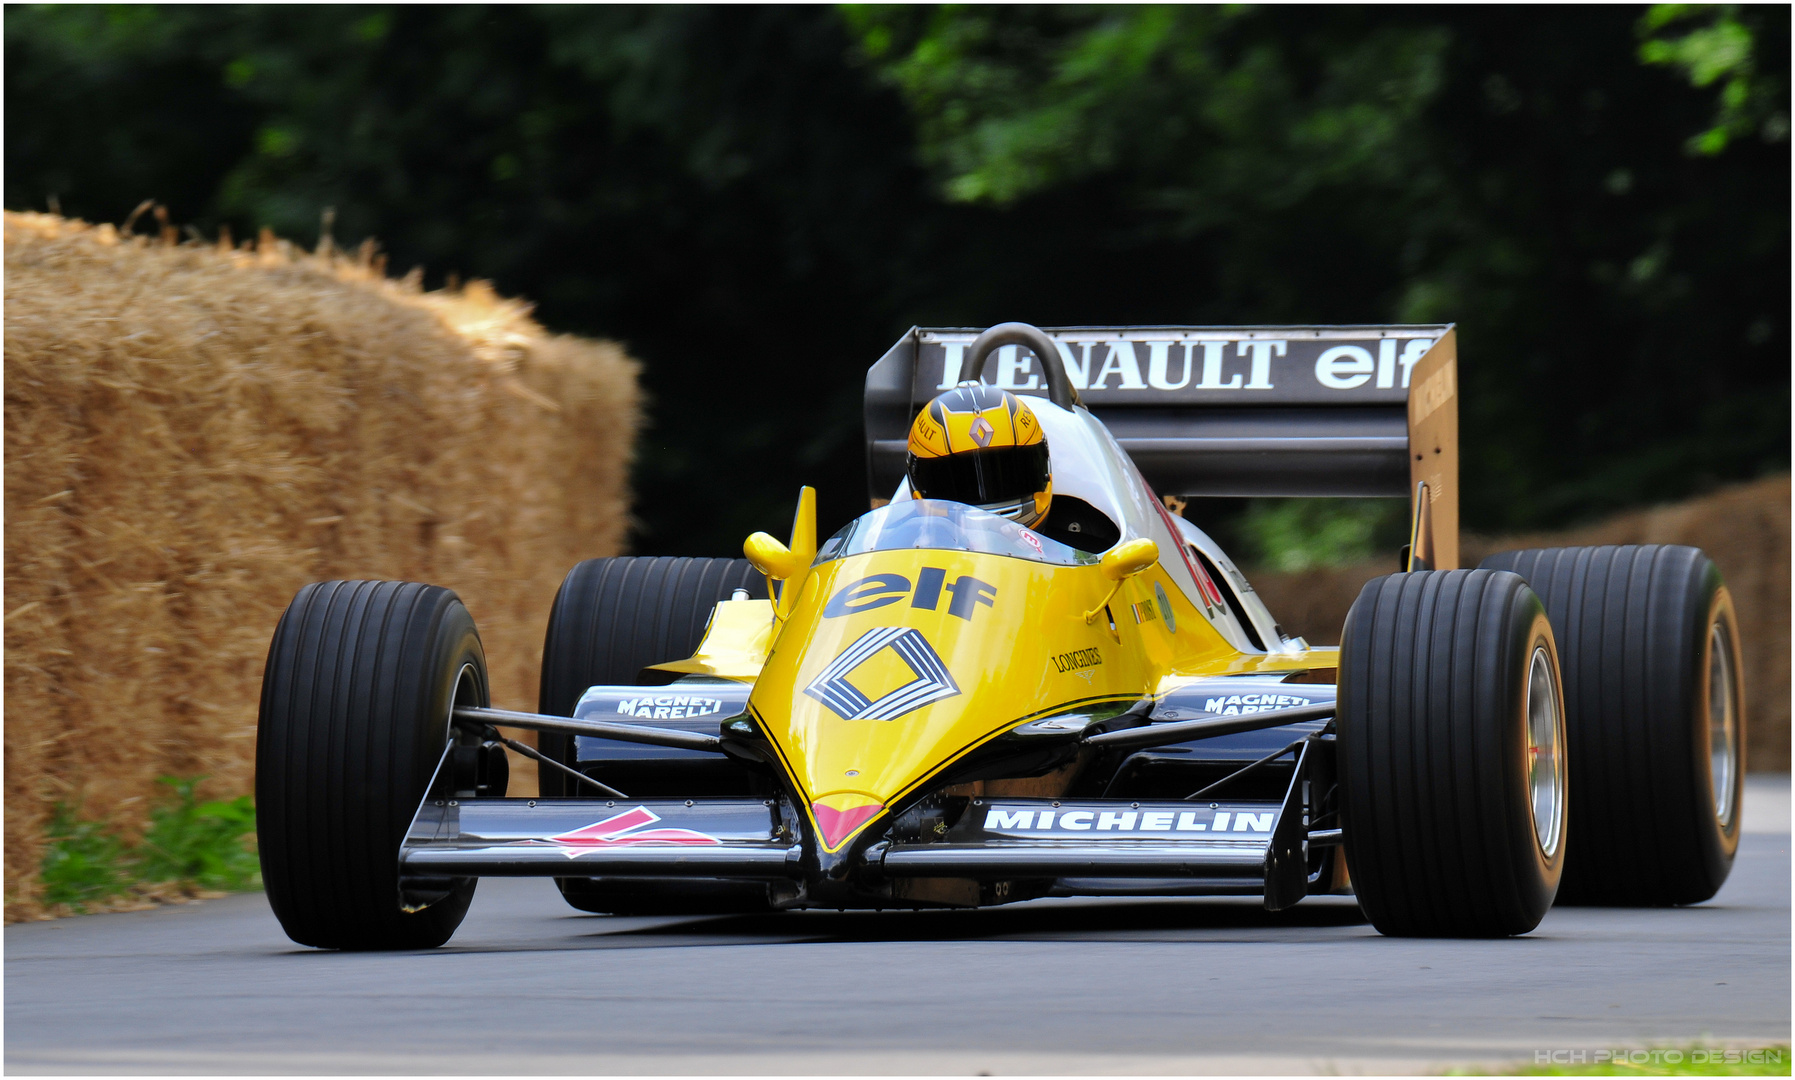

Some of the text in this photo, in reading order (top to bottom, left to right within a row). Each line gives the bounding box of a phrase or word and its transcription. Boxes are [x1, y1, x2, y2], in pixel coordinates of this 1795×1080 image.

[822, 567, 997, 621] elf
[1051, 647, 1102, 673] LONGINES
[617, 696, 722, 714] MAGNETI
[617, 700, 722, 719] MARELLI
[983, 810, 1275, 832] MICHELIN
